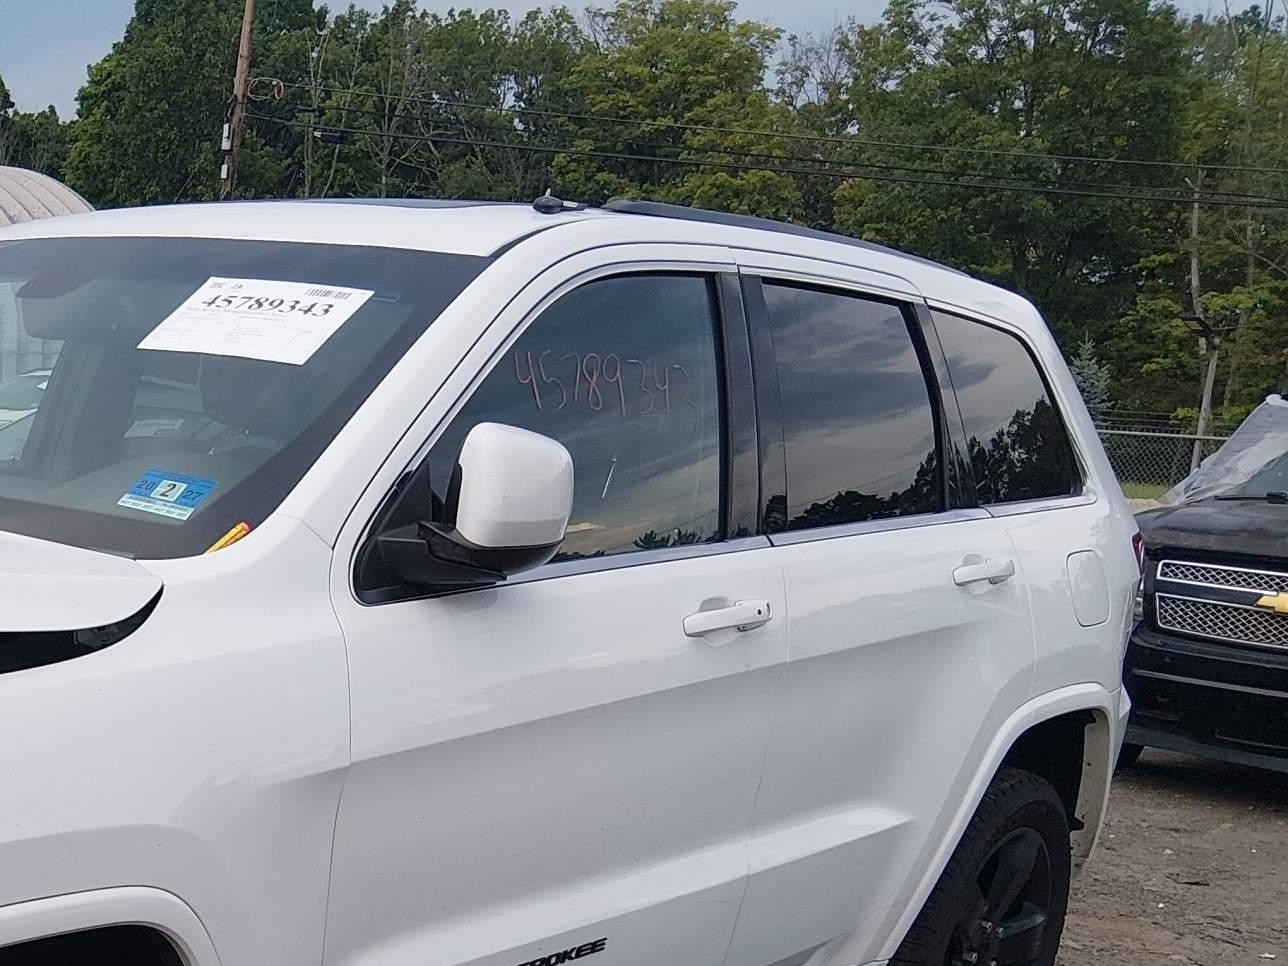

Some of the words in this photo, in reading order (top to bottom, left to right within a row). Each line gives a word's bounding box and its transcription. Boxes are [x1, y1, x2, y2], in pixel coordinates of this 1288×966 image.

[202, 294, 335, 318] 45789343
[515, 350, 698, 439] 45789343
[136, 480, 155, 491] 20
[159, 483, 177, 498] 2
[182, 489, 203, 501] 27
